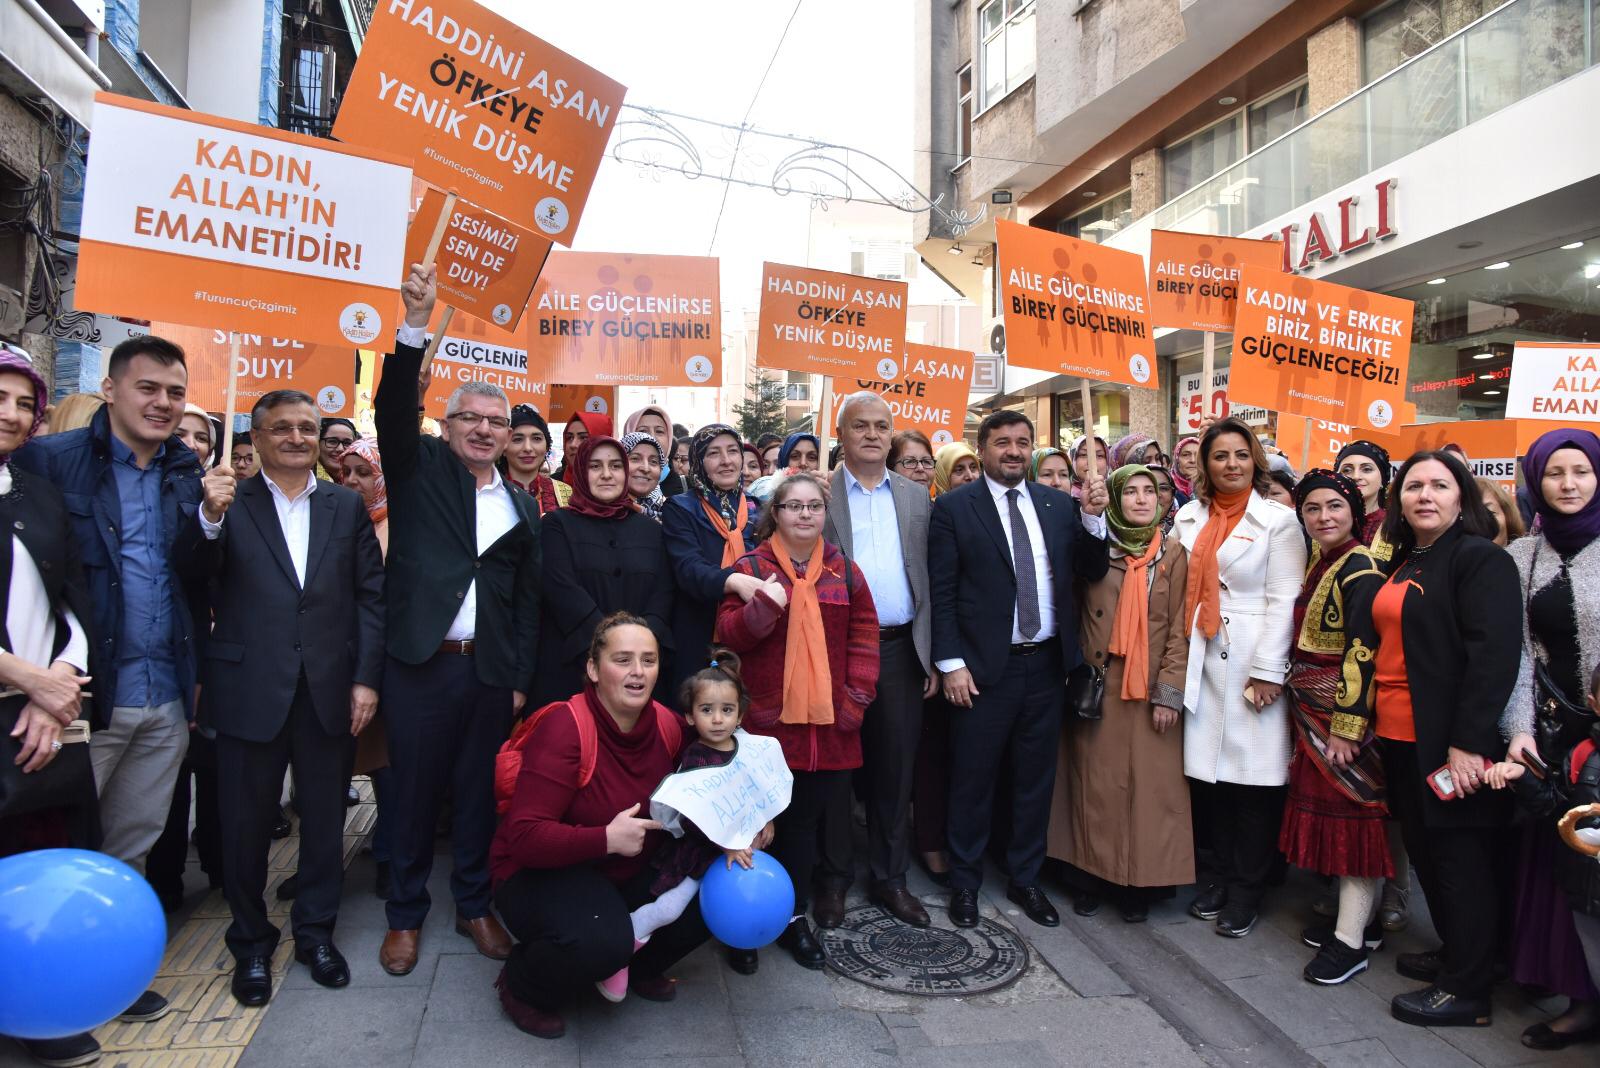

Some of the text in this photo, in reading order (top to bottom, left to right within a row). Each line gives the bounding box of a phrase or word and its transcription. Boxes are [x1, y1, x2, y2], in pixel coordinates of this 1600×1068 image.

[388, 0, 611, 129] HADDİNİ AŞAN
[430, 53, 544, 135] ÖFKEYE
[377, 72, 575, 192] YENİK DÜŞME
[195, 138, 321, 192] KADIN,
[423, 147, 504, 192] #TuruncuÇizgimiz
[170, 173, 337, 227] ALLAH'IN
[133, 206, 363, 271] EMANETİDİR!
[451, 212, 520, 252] SESİMİZİ
[446, 236, 505, 272] SEN DE
[1156, 260, 1185, 276] AİLE
[448, 262, 489, 291] DUY!
[768, 276, 902, 310] HADDİNİ AŞAN
[1008, 266, 1144, 314] AİLE GÜÇLENİRSE
[1157, 278, 1194, 295] BİREY
[194, 289, 297, 315] #TuruncuÇizgimiz
[537, 290, 712, 316] AİLE GÜÇLENİRSE
[797, 300, 866, 327] ÖFKEYE
[1012, 294, 1146, 339] BİREY GÜÇLENİR!
[1245, 287, 1403, 336] KADIN VE ERKEK
[212, 329, 262, 346] SN
[539, 315, 711, 341] BİREY GÜÇLENİR!
[773, 323, 892, 354] YENİK DÜŞME
[1266, 315, 1393, 359] BİRİZ, BİRLİKTE
[913, 358, 965, 380] AŞAN
[1241, 336, 1400, 386] GÜÇLENECEĞİZ!
[1188, 379, 1200, 391] BU
[889, 400, 951, 425] DÜŞME
[1318, 420, 1350, 435] SEN
